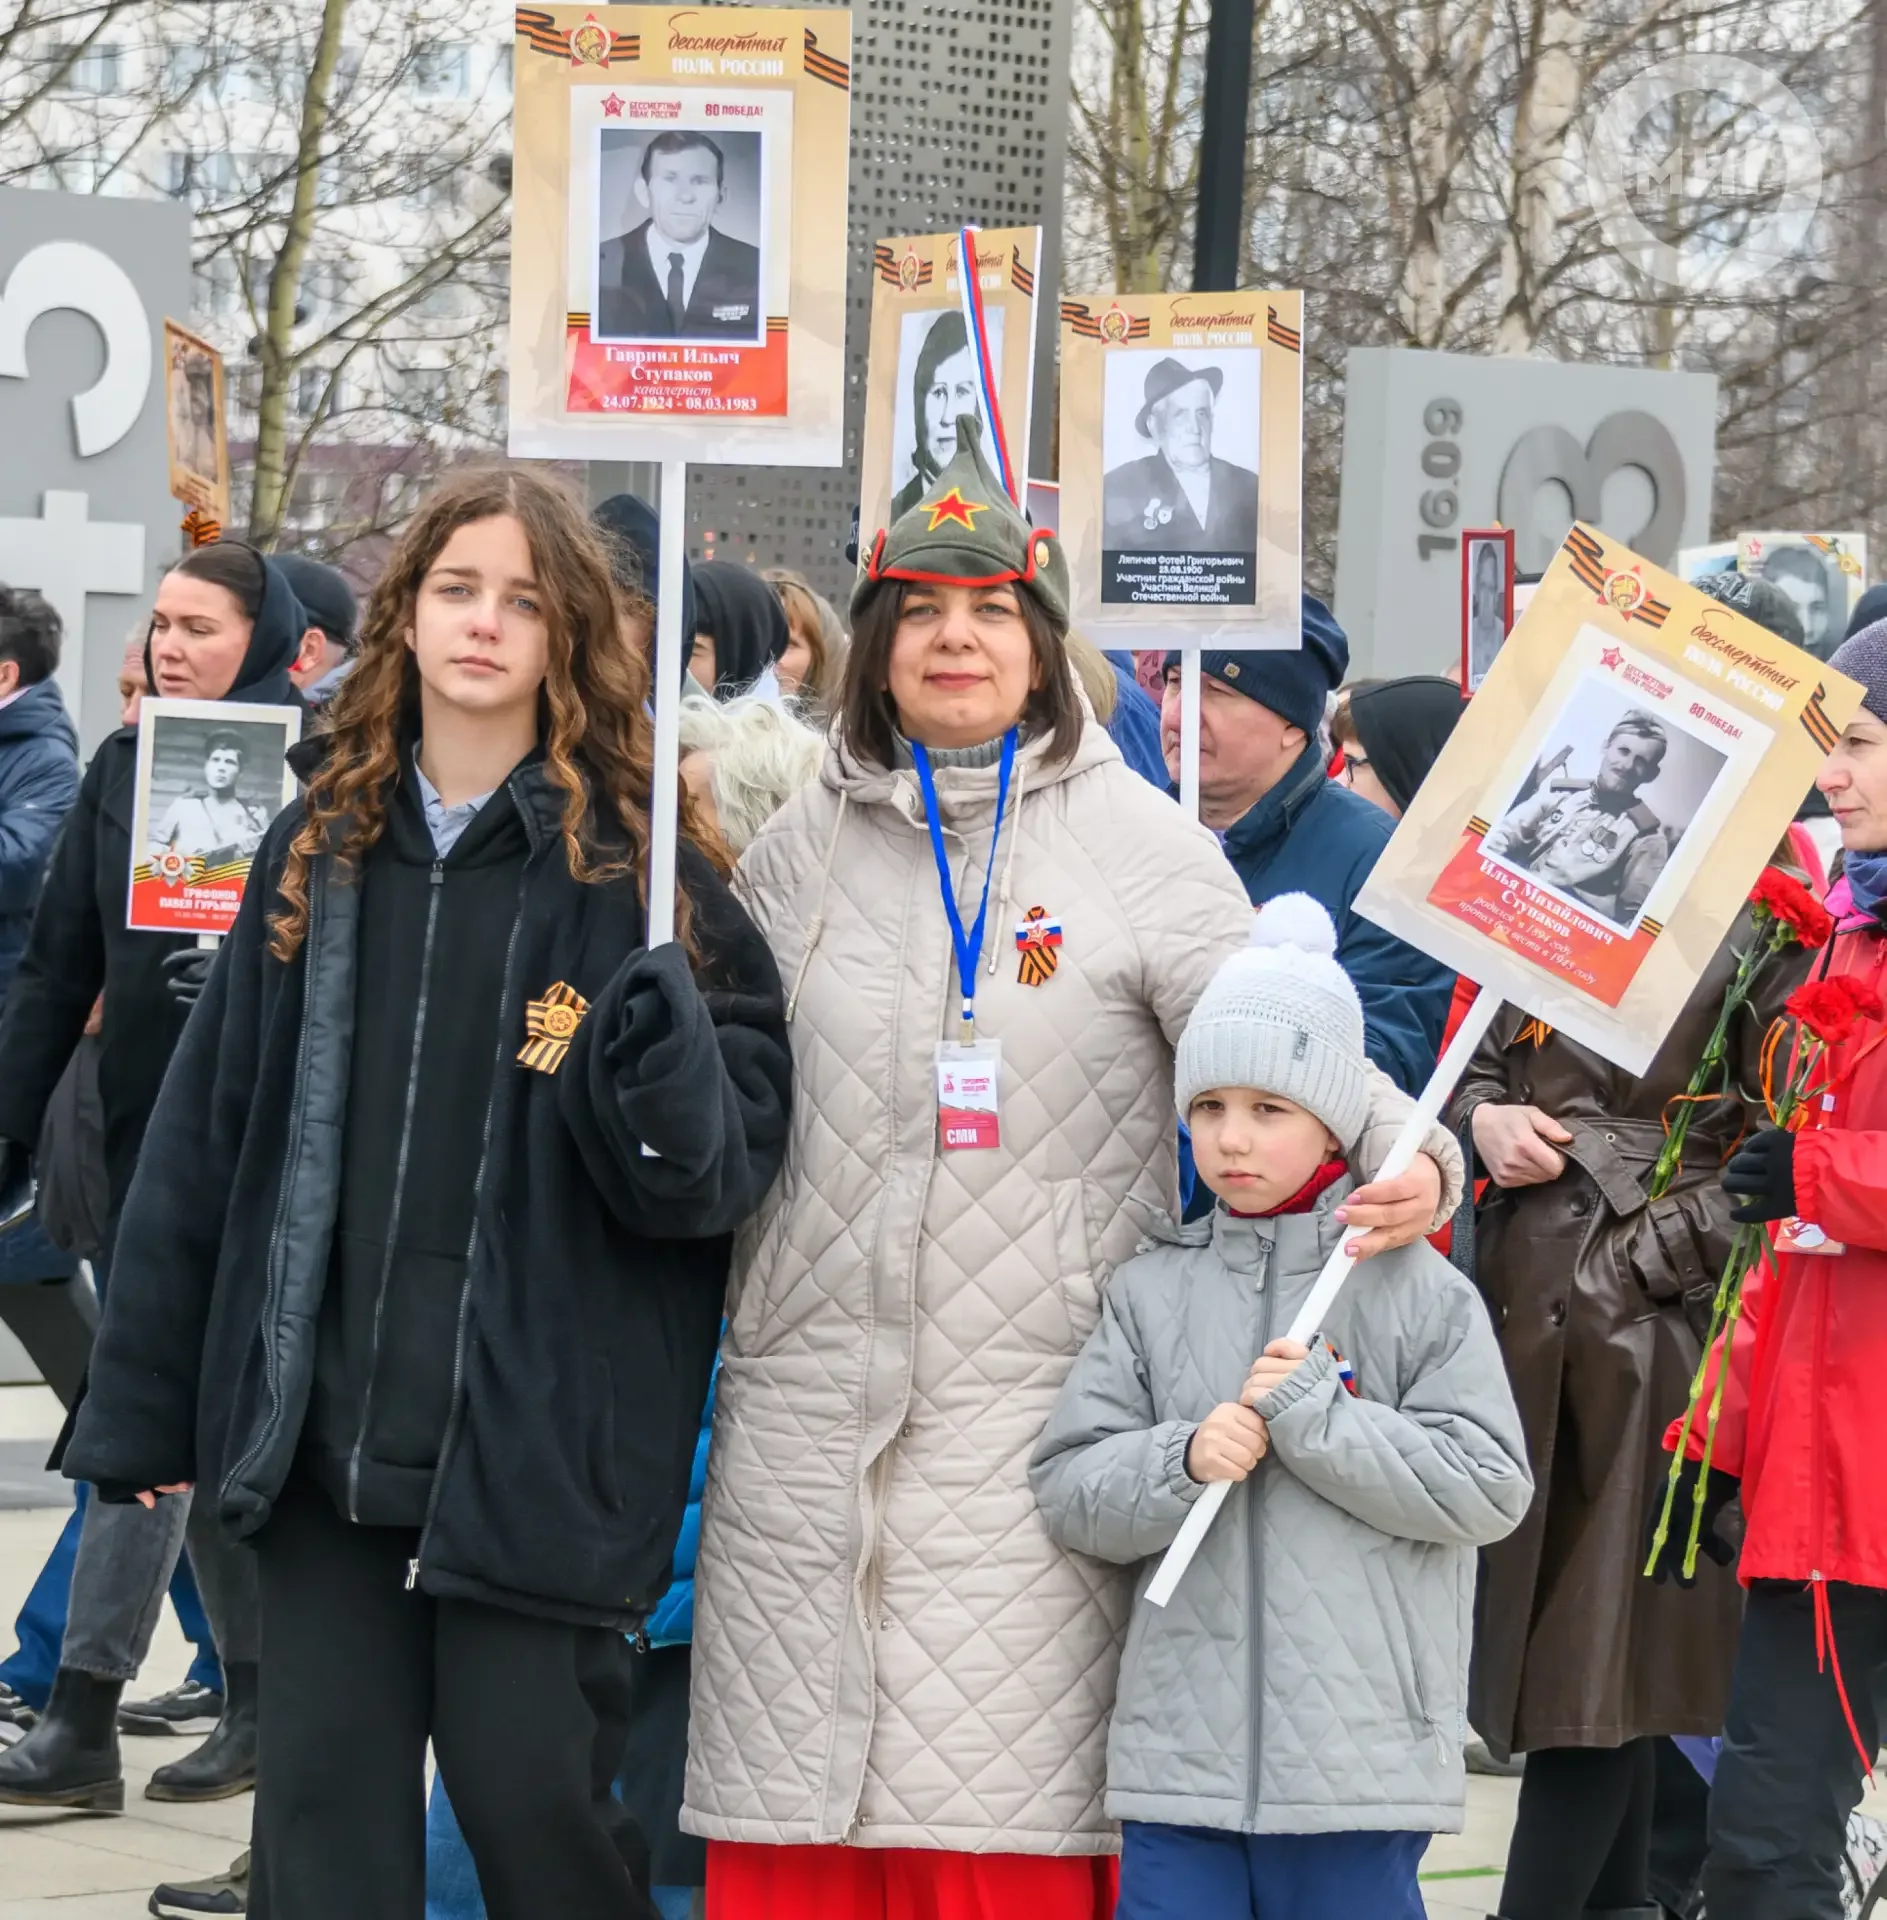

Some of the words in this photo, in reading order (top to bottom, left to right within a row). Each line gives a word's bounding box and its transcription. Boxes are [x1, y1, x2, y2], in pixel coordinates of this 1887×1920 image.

[668, 12, 788, 56] бессмертный
[671, 57, 715, 74] ПОЛК
[720, 58, 784, 76] РОССИИ
[705, 103, 720, 116] 80
[722, 105, 763, 118] ПОБЕДА!
[606, 347, 678, 366] Гавриил
[683, 348, 740, 365] Ильич
[631, 366, 713, 384] Ступаков
[633, 386, 712, 398] кавалерист
[602, 396, 673, 409] 24.07.1924
[686, 398, 757, 411] 08.03.1983
[1417, 397, 1463, 562] 16.09
[1116, 573, 1156, 583] Участник
[1141, 583, 1181, 592] Участник
[1183, 583, 1220, 593] Великой
[1689, 702, 1705, 719] 80
[1705, 712, 1743, 740] ПОБЕДА!
[1473, 896, 1515, 923] родился
[1479, 859, 1520, 890] Илья
[1522, 882, 1614, 946] Михайлович
[1501, 889, 1571, 938] Ступаков
[1511, 932, 1541, 952] вести
[947, 1128, 977, 1144] СМИ
